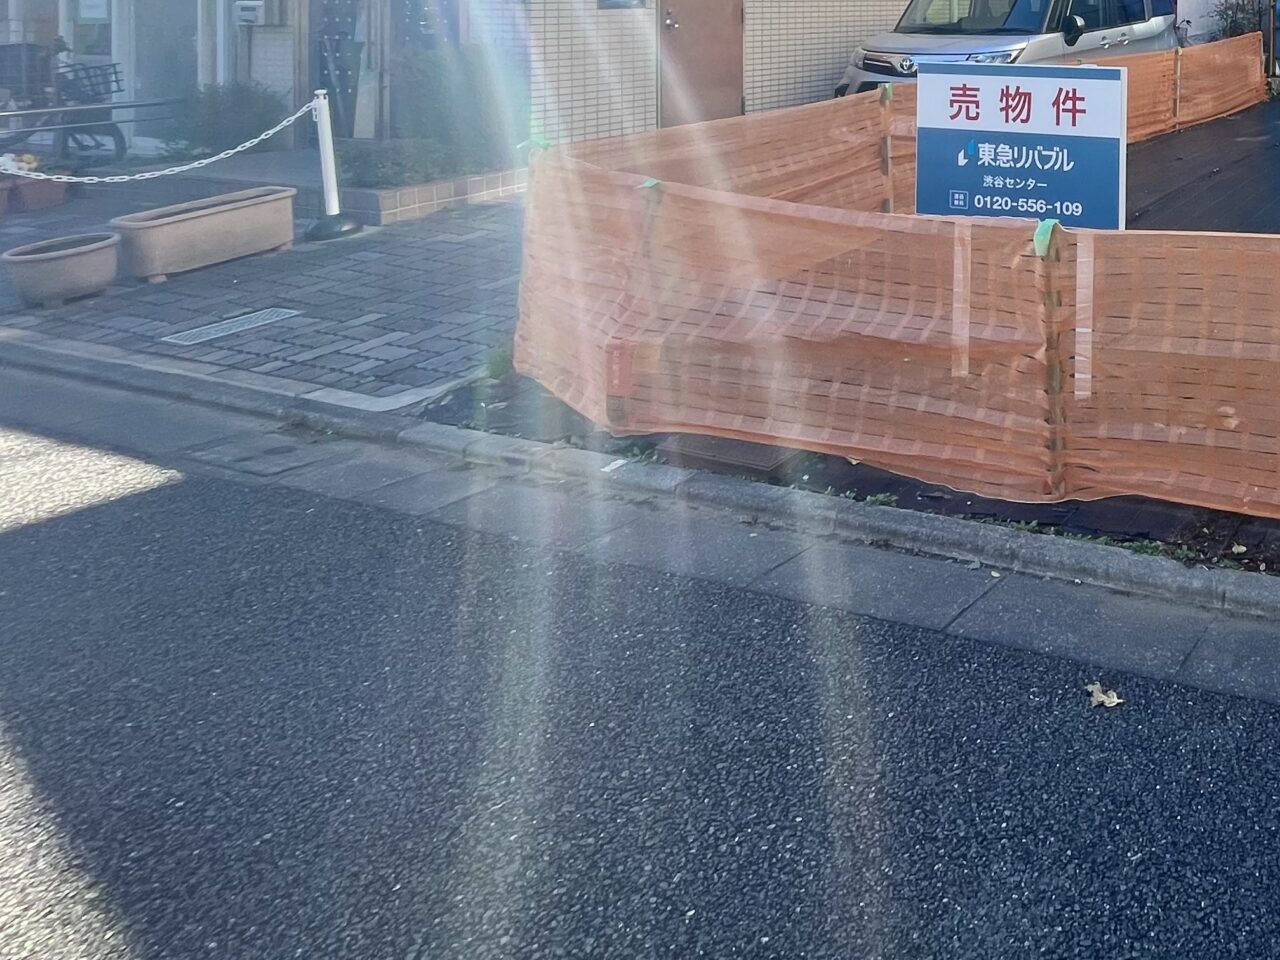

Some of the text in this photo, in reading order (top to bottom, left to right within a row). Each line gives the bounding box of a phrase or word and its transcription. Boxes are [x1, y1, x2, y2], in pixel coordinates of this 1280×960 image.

[949, 83, 1087, 127] 売物件
[977, 142, 1075, 172] 東急リバブル
[983, 175, 1048, 190] 渋谷センター
[974, 194, 1083, 216] 0120-556-109
